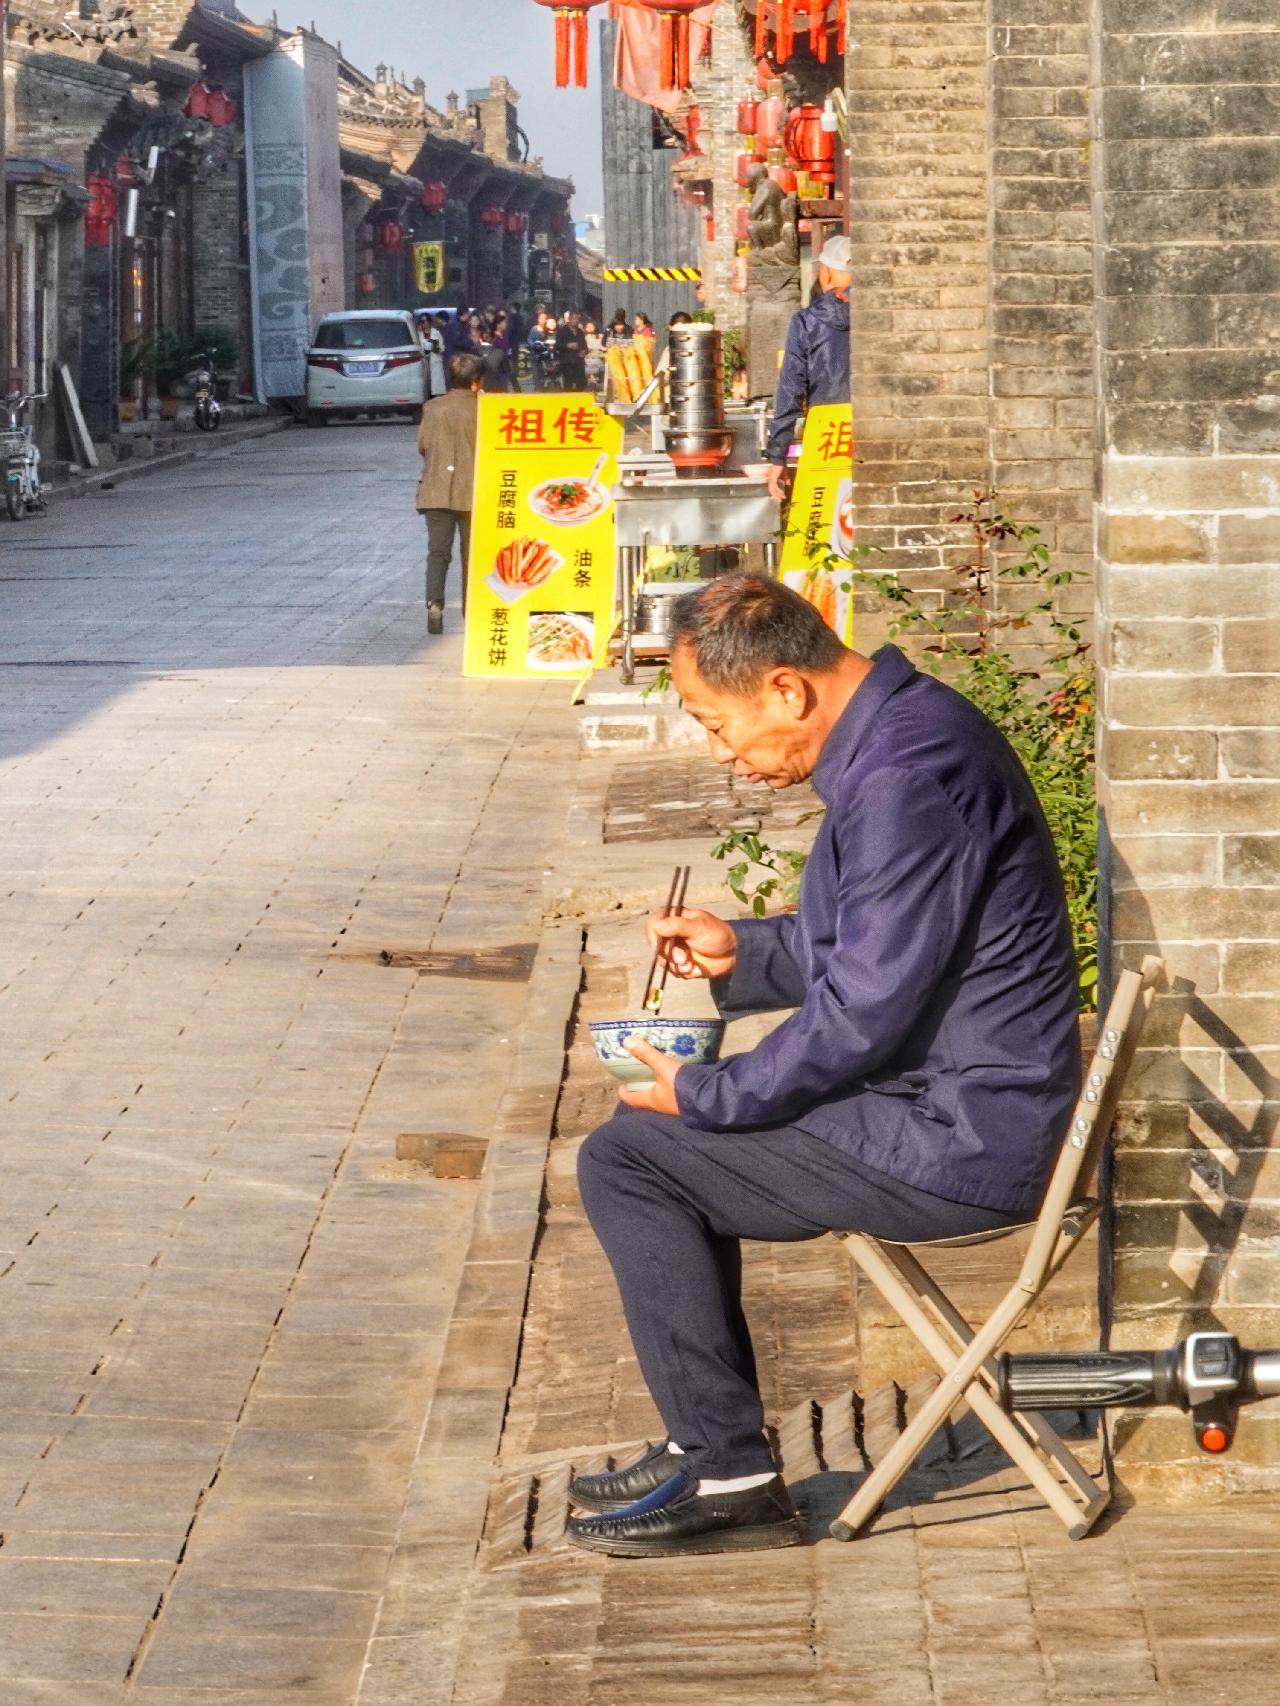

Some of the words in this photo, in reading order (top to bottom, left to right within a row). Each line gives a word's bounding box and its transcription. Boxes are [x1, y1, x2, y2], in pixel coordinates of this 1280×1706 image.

[498, 408, 601, 445] 祖传
[495, 469, 518, 530] 豆腐脑
[573, 549, 593, 588] 油条
[487, 608, 511, 667] 葱花饼
